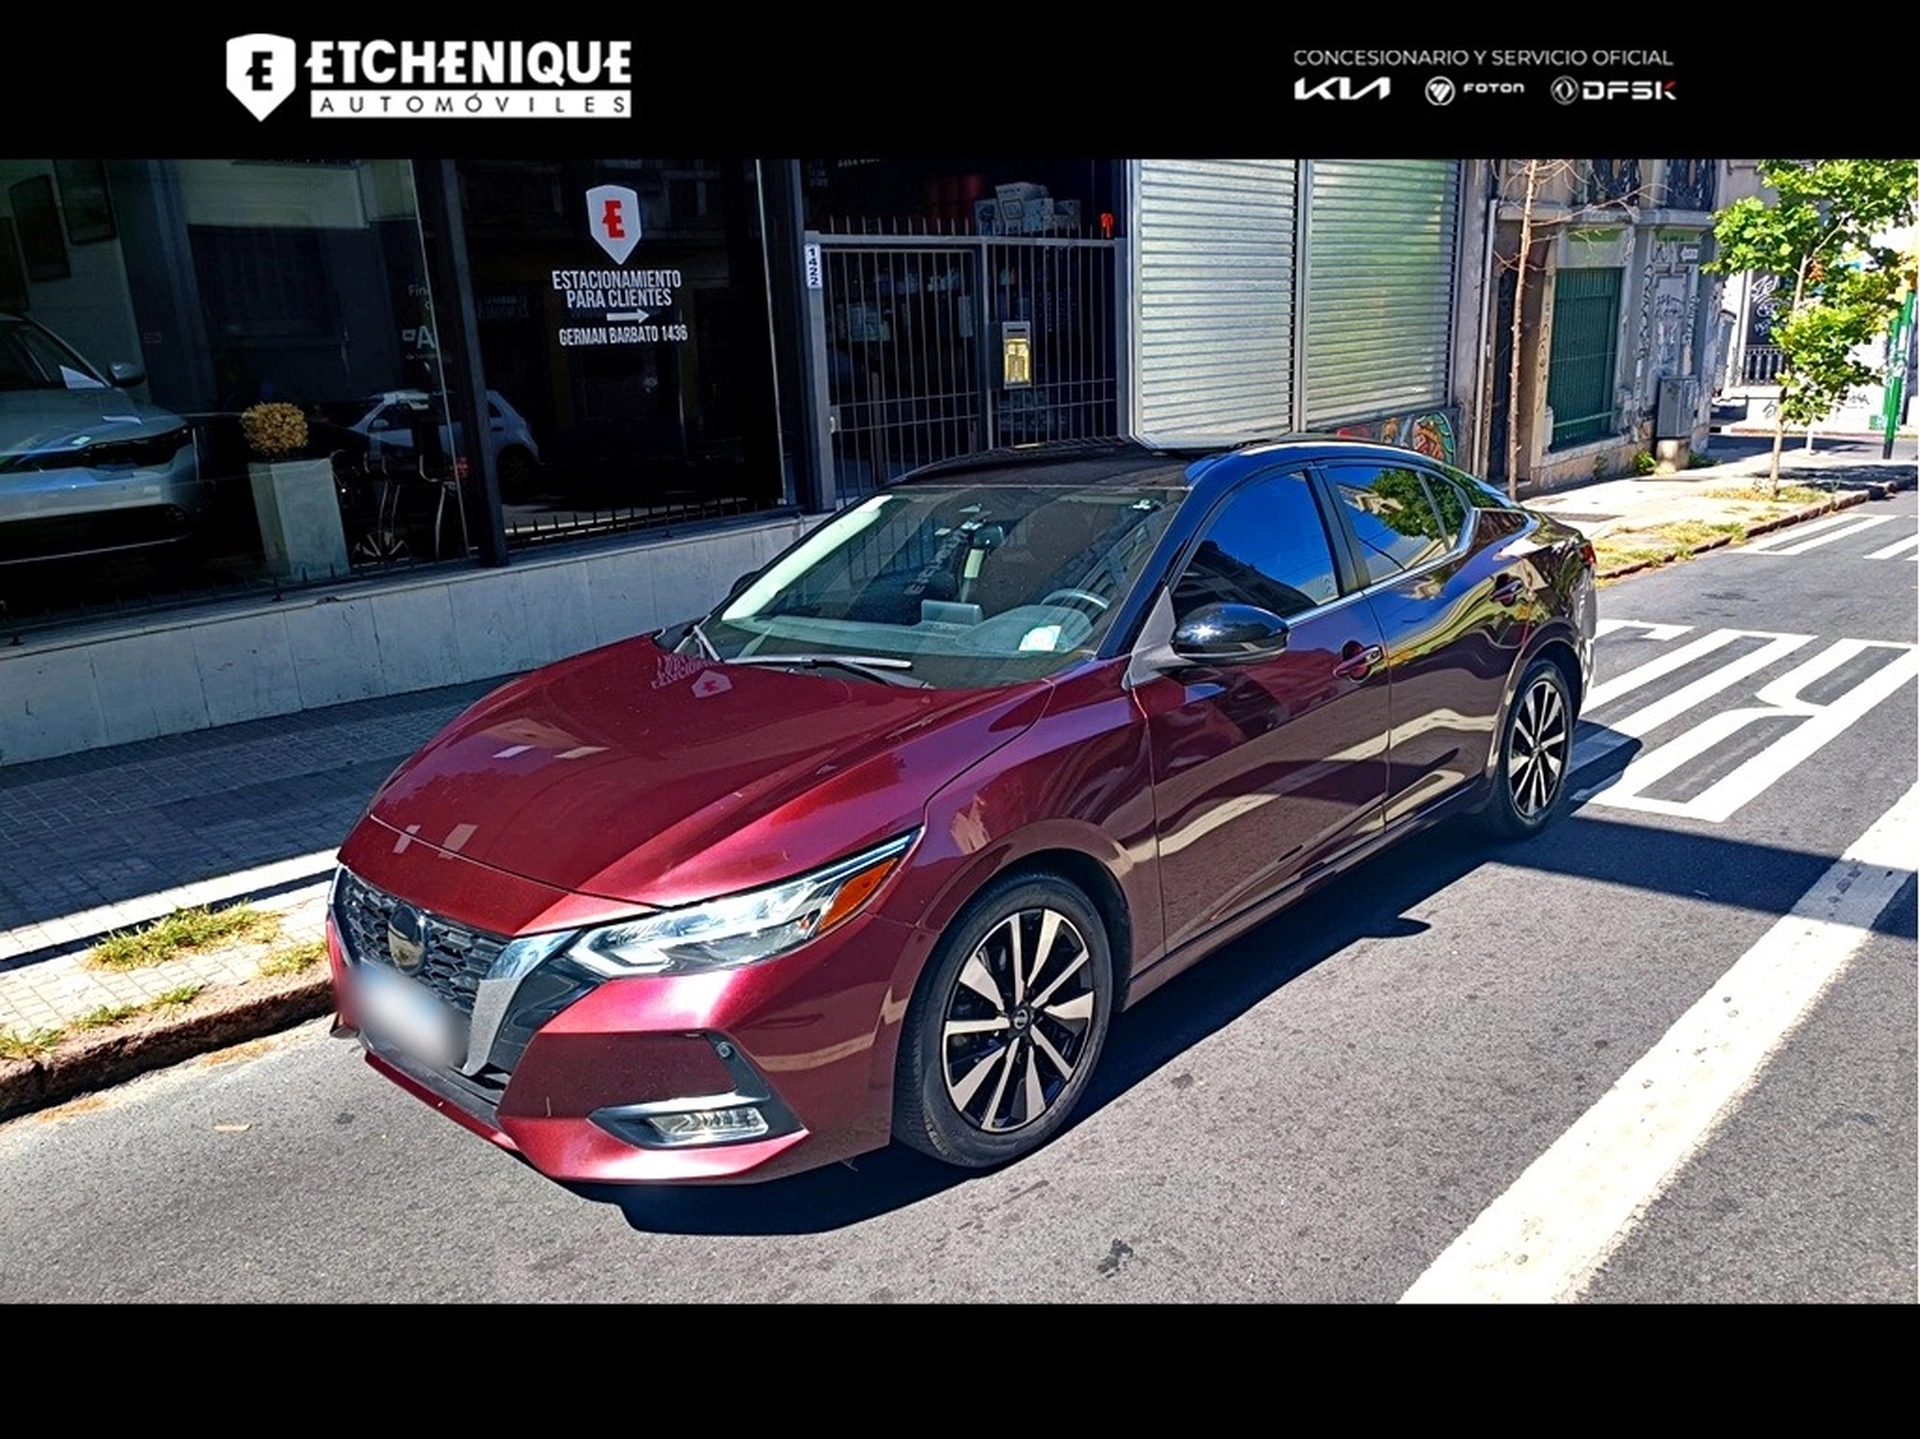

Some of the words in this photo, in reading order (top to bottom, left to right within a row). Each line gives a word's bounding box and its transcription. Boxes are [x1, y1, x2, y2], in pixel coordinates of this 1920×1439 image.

[808, 247, 819, 286] 1422
[552, 269, 682, 290] ESTACIONAMIENTO
[566, 290, 606, 309] PARA
[608, 288, 672, 307] CLIENTES
[559, 327, 608, 346] GERMAN
[608, 324, 659, 344] BARBATO
[661, 323, 689, 342] 1436
